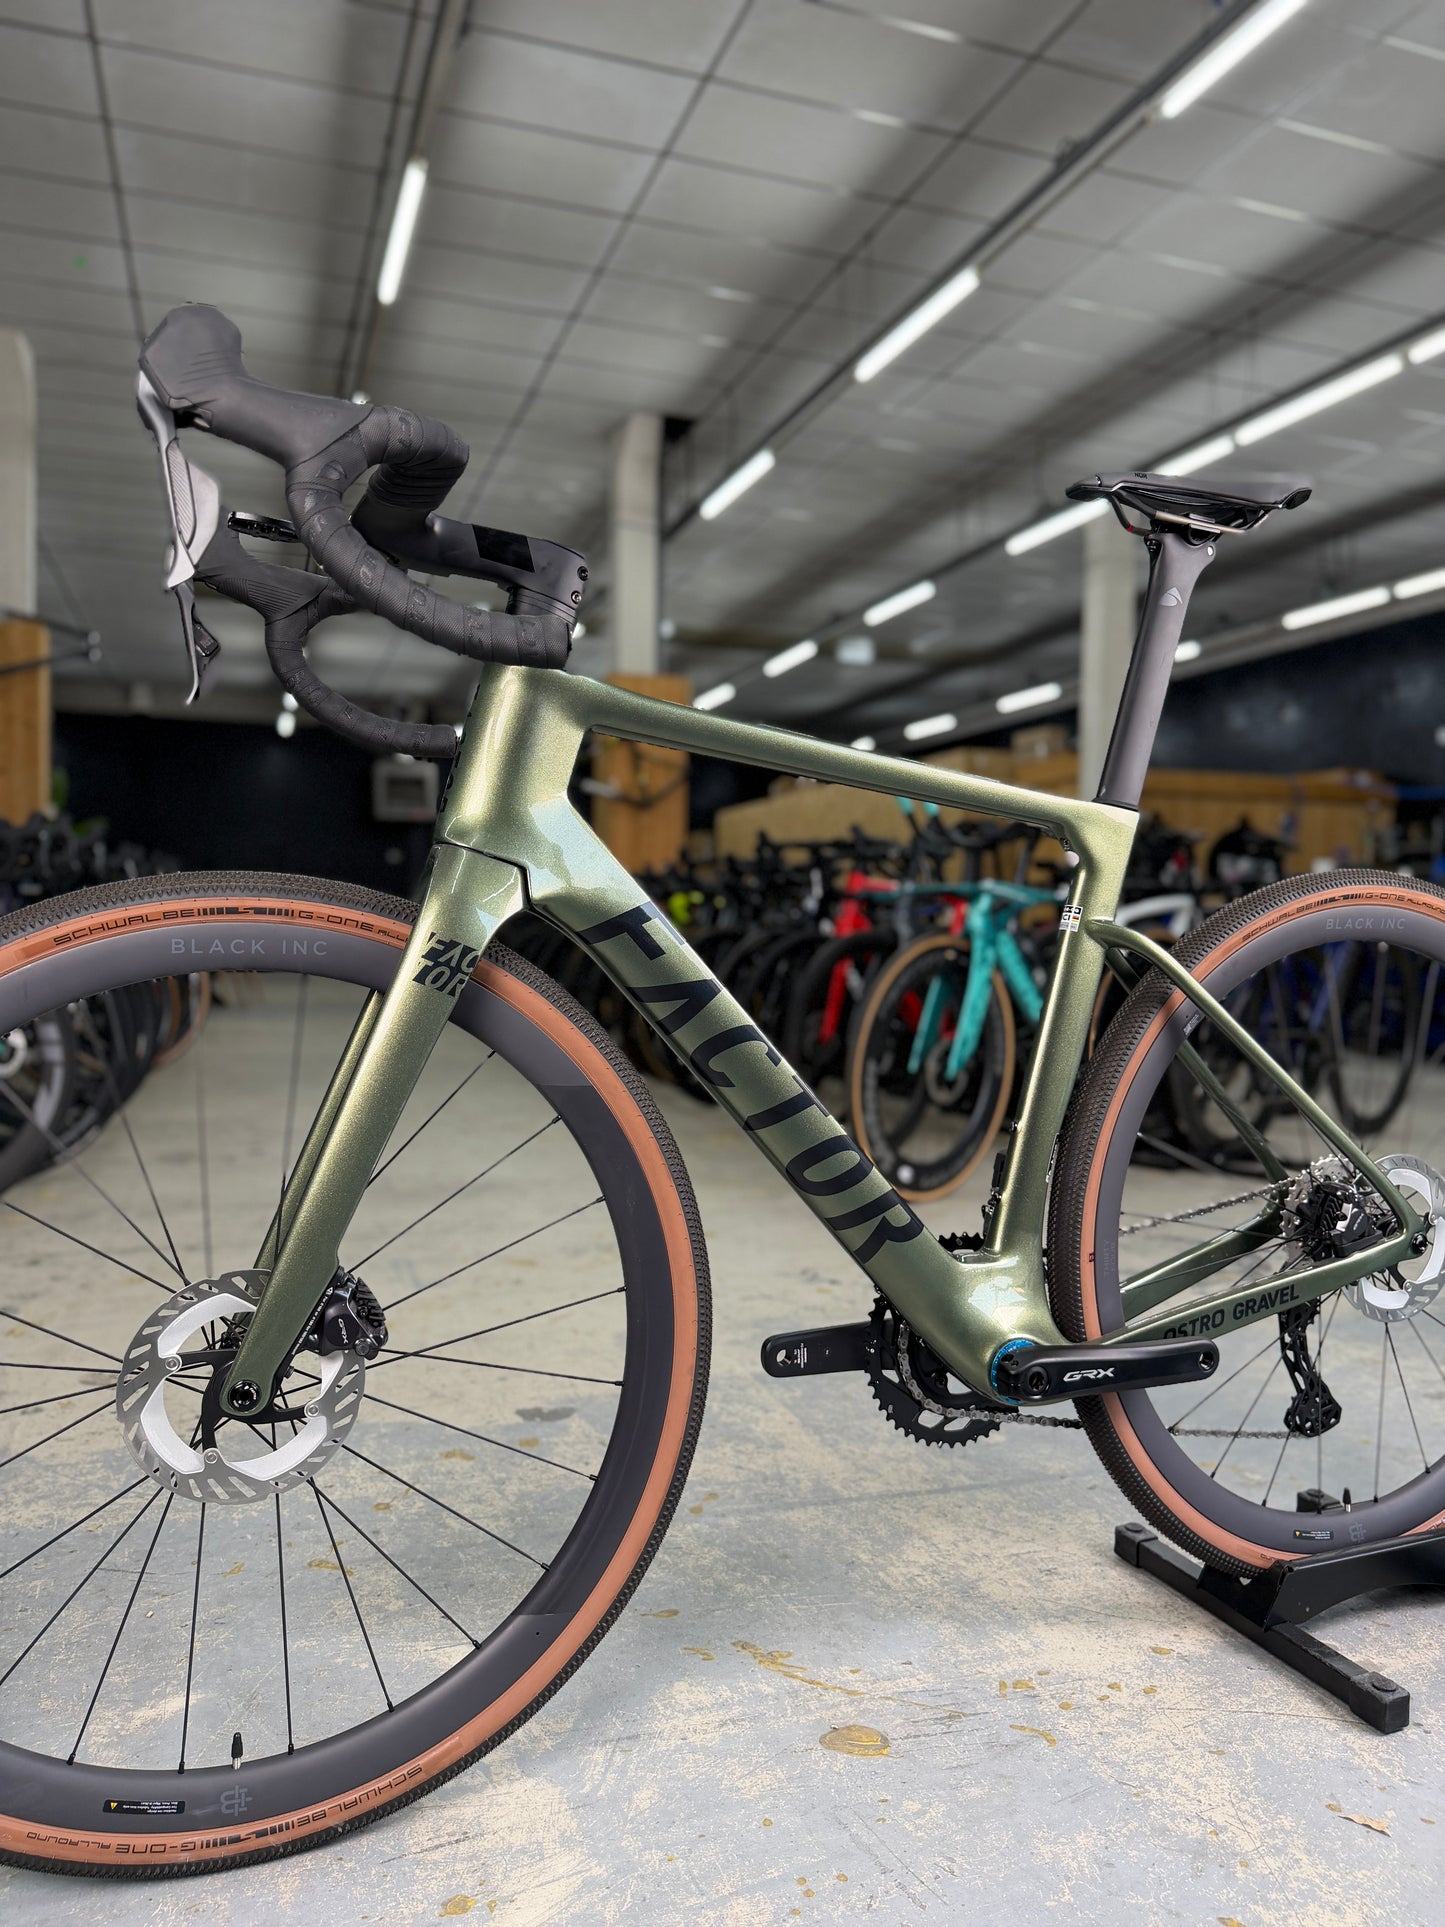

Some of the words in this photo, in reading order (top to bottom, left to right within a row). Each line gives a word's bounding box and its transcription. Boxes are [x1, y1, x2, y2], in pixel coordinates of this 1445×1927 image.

[53, 908, 195, 946] SCHWALBE
[298, 910, 374, 931] G-ONE
[1242, 902, 1314, 942] SCHWALBE
[1365, 892, 1406, 902] G-ONE
[1325, 918, 1374, 930] BLACK
[1380, 918, 1406, 930] INC
[170, 938, 265, 954] BLACK
[281, 940, 328, 956] INC
[576, 901, 925, 1264] FACTOR
[1163, 1310, 1225, 1339] OSTRO
[1232, 1284, 1300, 1321] GRAVEL
[338, 1318, 349, 1344] GRX
[1063, 1367, 1115, 1382] GRX
[297, 1764, 423, 1827] SCHWALBE
[26, 1831, 111, 1850] ALLROUND
[114, 1841, 196, 1854] G-ONE
